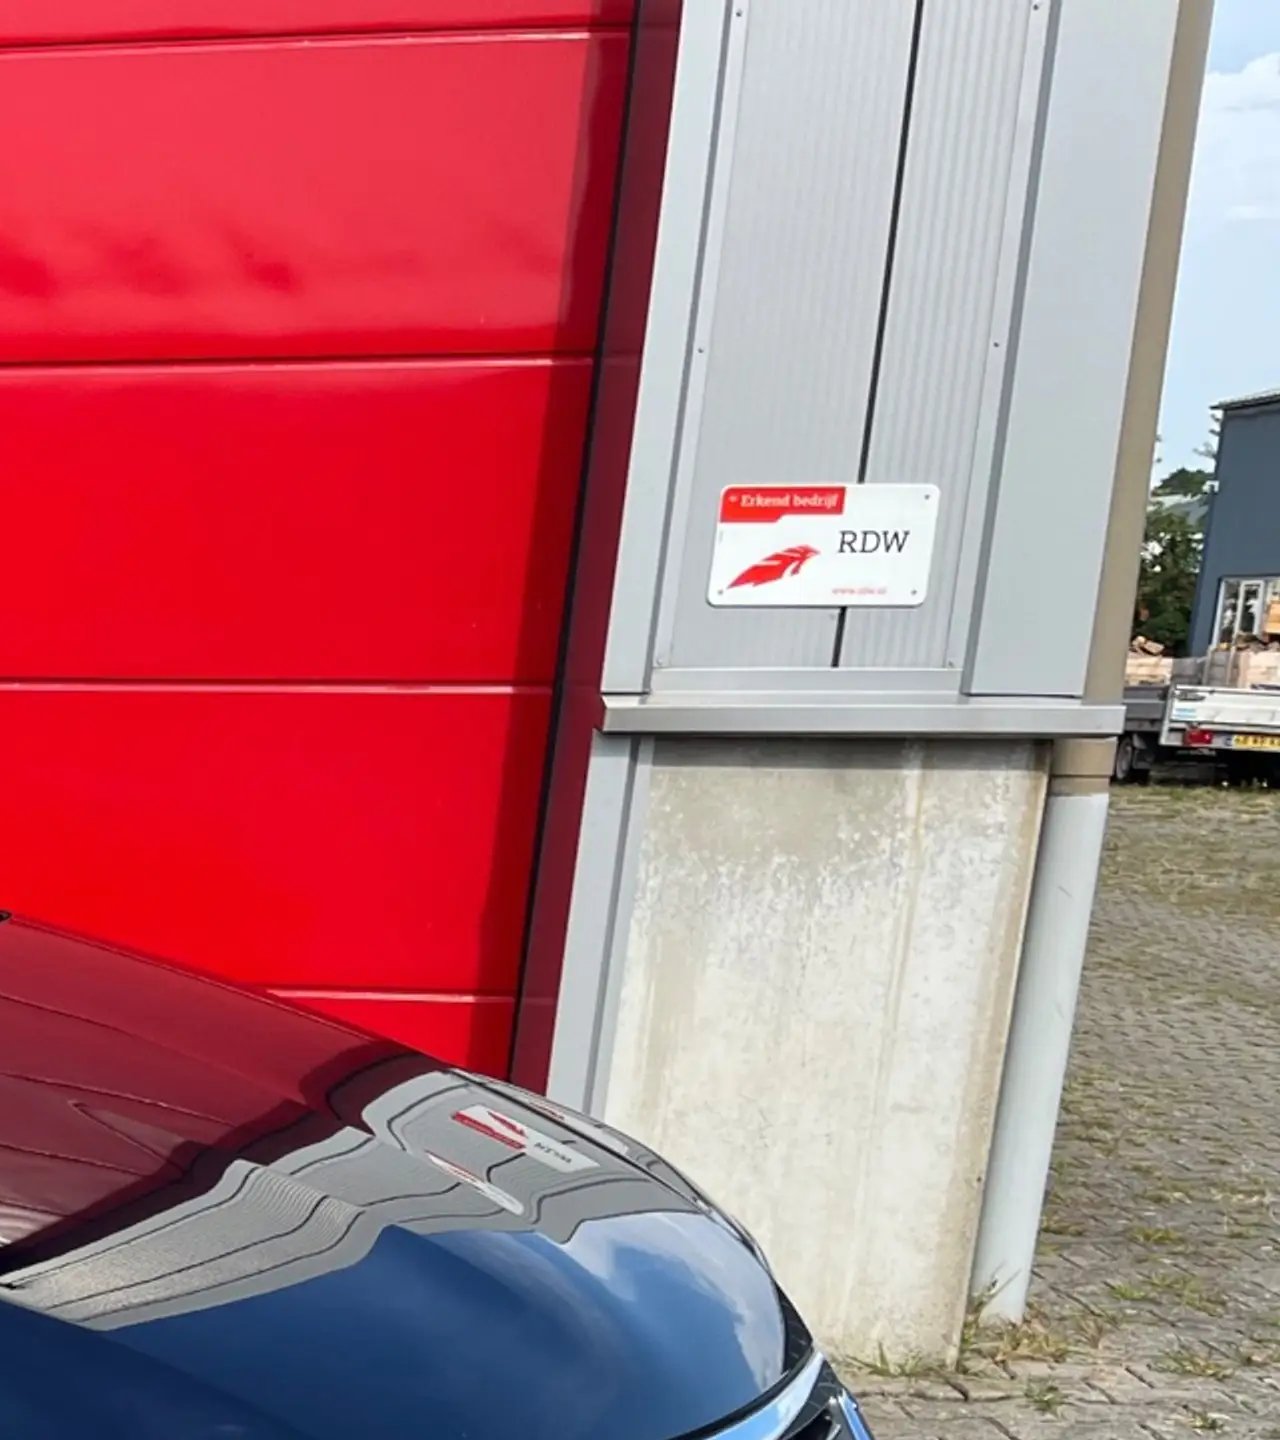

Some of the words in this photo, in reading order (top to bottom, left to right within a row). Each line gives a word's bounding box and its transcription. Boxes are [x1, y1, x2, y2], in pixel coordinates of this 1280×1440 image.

[740, 494, 790, 508] Erkend
[793, 494, 839, 510] bedrijf
[837, 529, 911, 554] RDW
